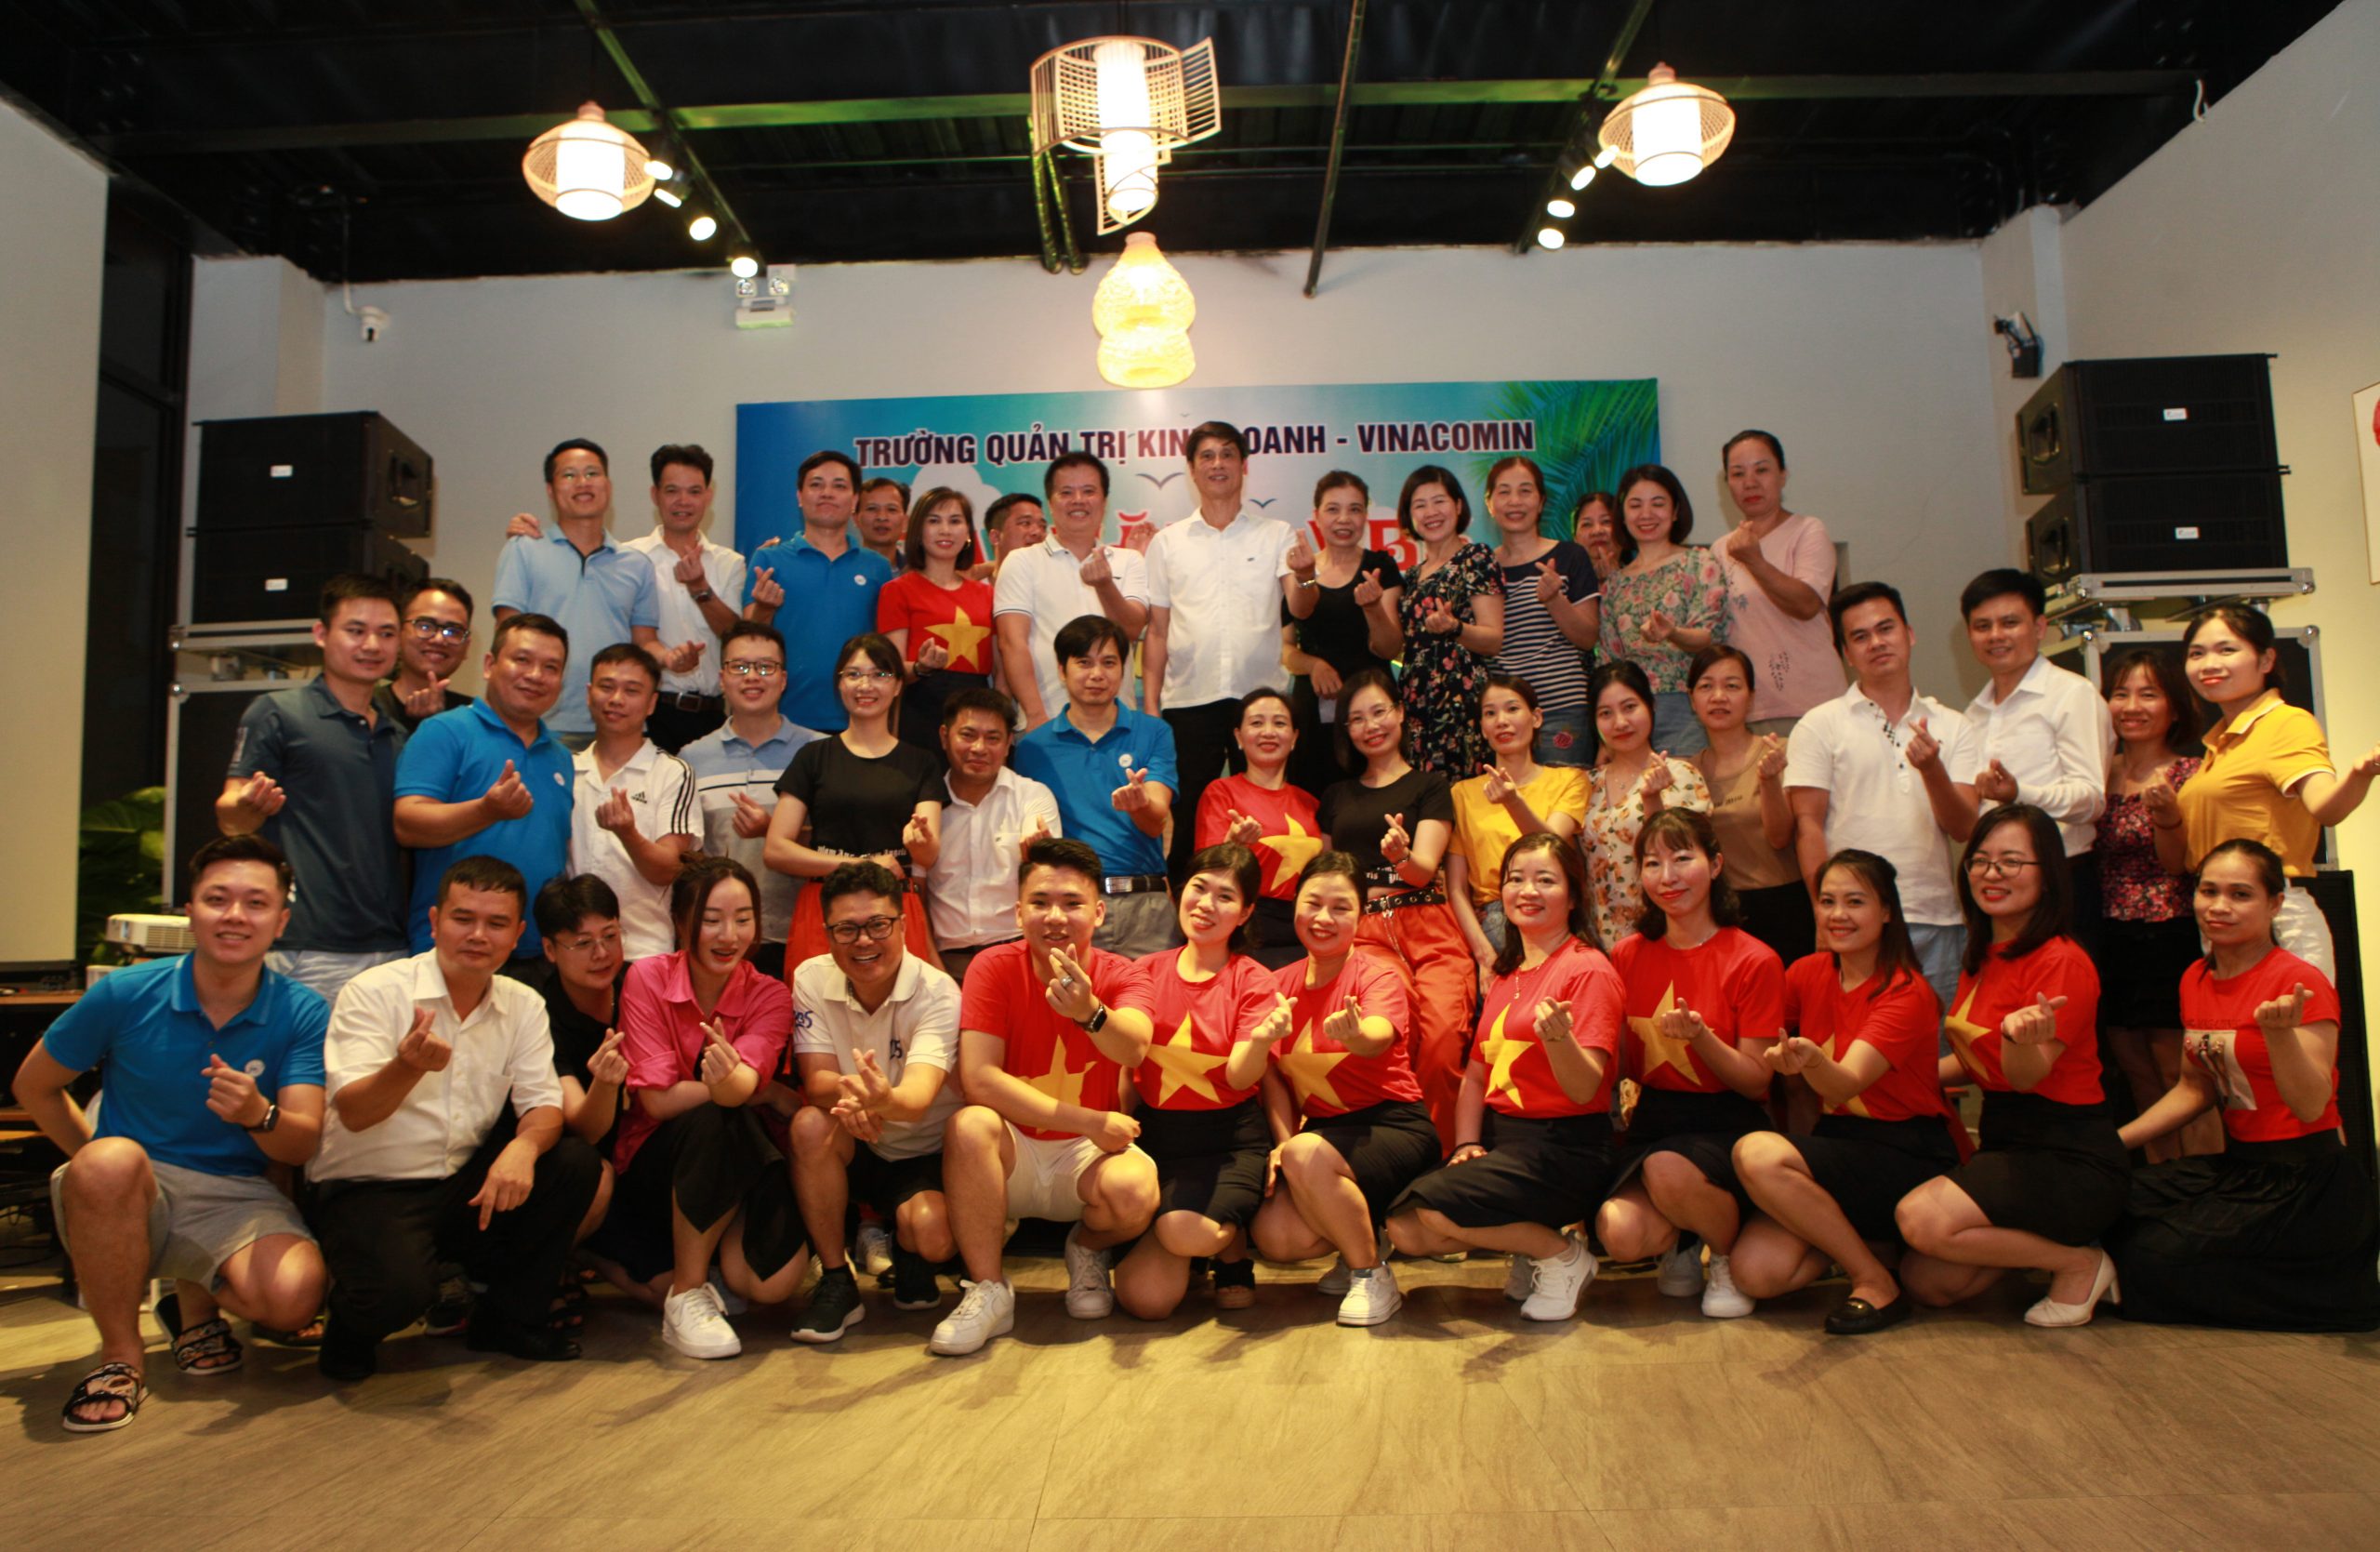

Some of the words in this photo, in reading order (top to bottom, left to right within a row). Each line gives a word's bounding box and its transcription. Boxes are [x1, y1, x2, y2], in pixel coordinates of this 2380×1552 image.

[854, 429, 976, 467] TRƯỜNG
[985, 423, 1070, 467] QUẢN
[1079, 431, 1126, 464] TRỊ
[1137, 428, 1196, 458] KIN
[1243, 425, 1326, 454] OANH
[1357, 421, 1534, 453] VINACOMIN
